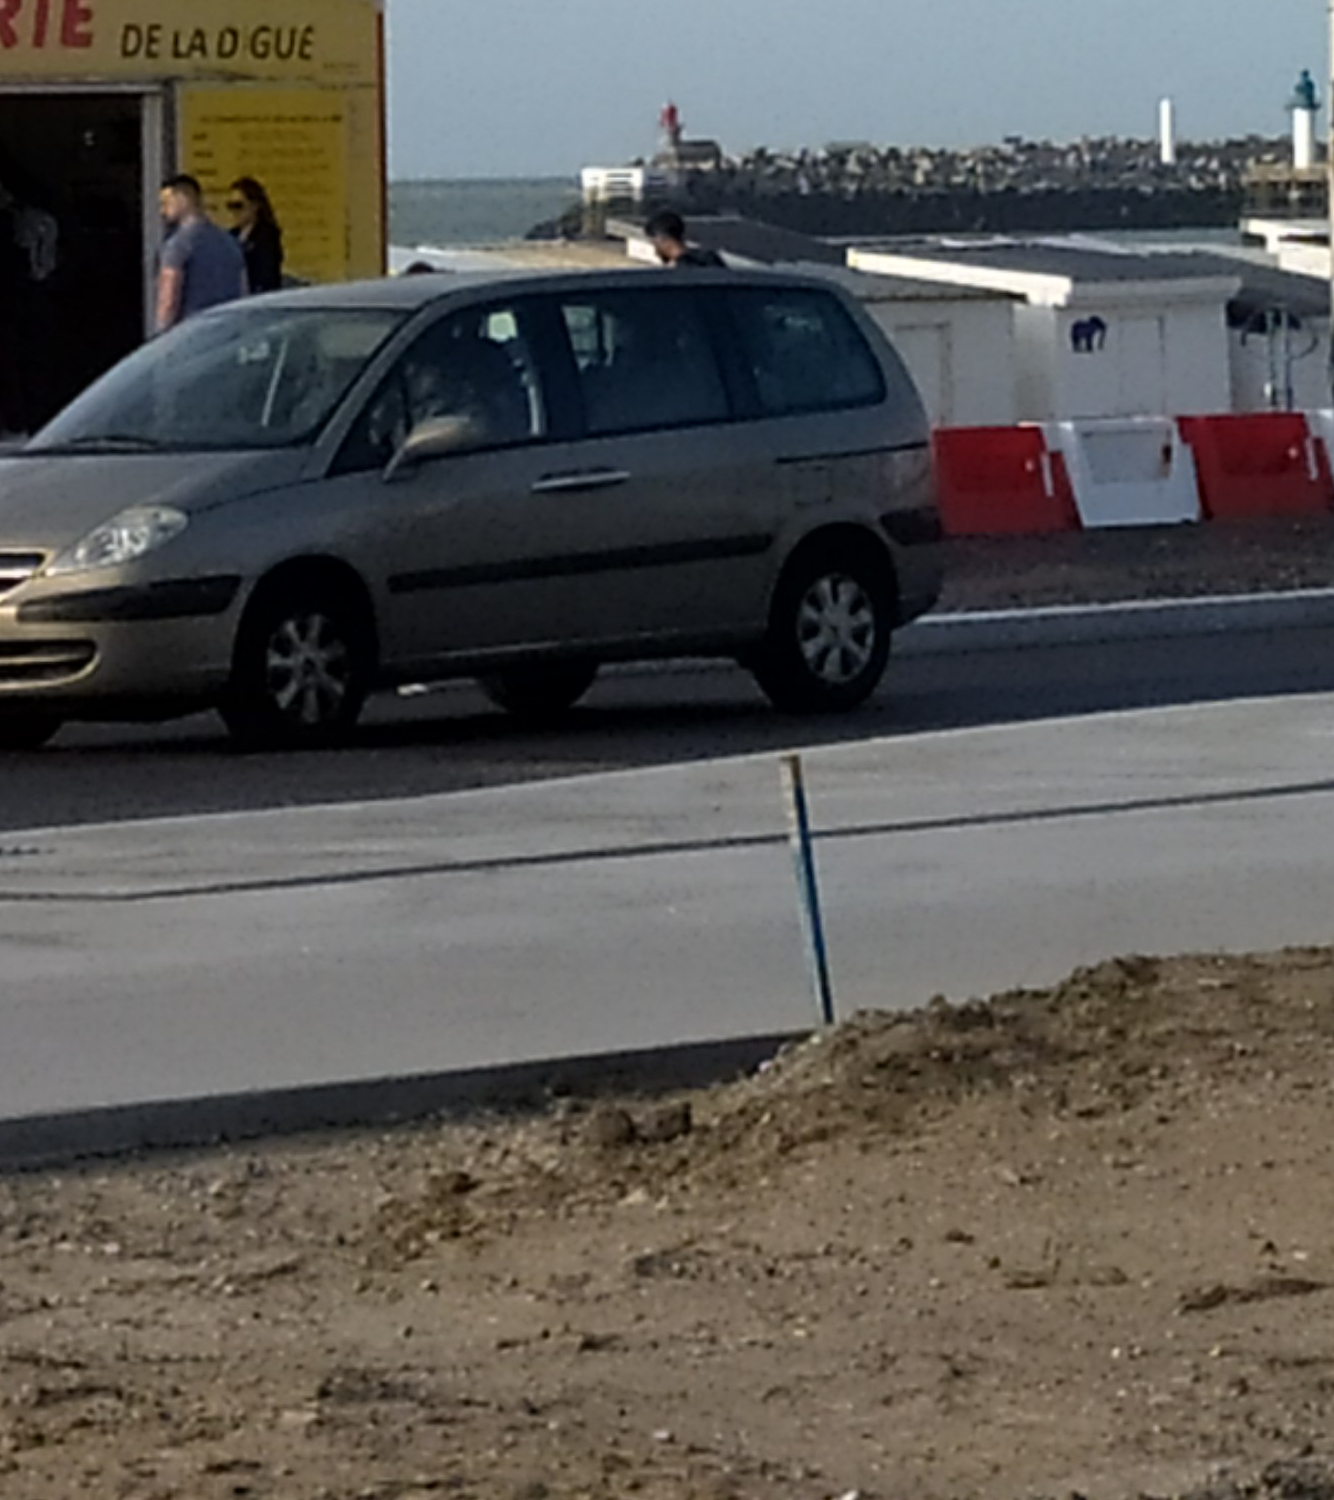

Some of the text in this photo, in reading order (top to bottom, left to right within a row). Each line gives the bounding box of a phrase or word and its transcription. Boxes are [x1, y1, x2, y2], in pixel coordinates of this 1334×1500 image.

[121, 23, 163, 59] DE
[172, 27, 208, 59] LA
[217, 25, 315, 61] DGUE
